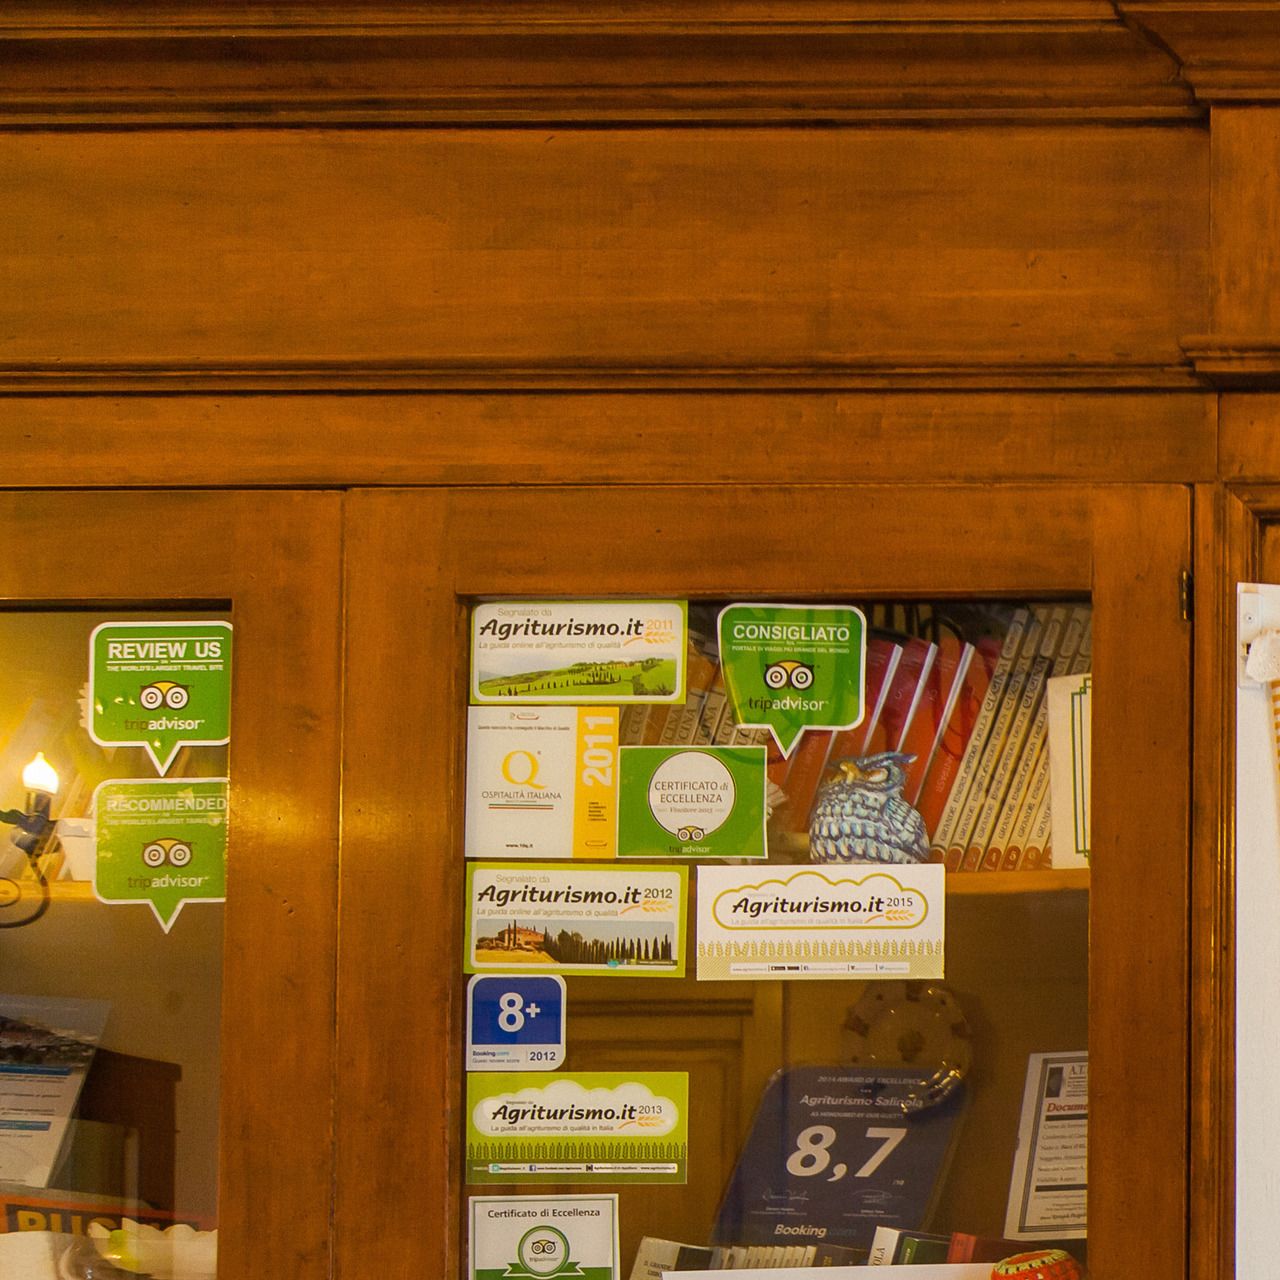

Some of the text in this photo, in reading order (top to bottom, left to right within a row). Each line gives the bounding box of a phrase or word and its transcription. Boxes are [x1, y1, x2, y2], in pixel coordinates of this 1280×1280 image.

[497, 608, 552, 618] Segnalato da
[479, 618, 673, 641] Agriturismo.it 2011
[733, 625, 850, 641] CONSIGLIATO
[108, 641, 221, 659] REVIEW US
[489, 642, 510, 650] guida
[596, 641, 621, 651] qualità
[749, 696, 824, 712] tripadvisor
[124, 716, 200, 733] tripadvisor
[582, 716, 614, 788] 2011
[502, 750, 547, 790] Q
[655, 781, 729, 791] CERTIFICATO di
[482, 790, 562, 799] OSPITALITÀ ITALIANA
[660, 794, 723, 803] ECCELLENZA
[107, 797, 227, 811] RECOMMENDED
[128, 874, 203, 890] tripadvisor
[495, 874, 539, 884] Segnalato
[477, 885, 673, 907] Agriturismo.it 2012
[487, 908, 508, 917] guida
[594, 910, 618, 918] qualità
[731, 896, 913, 917] Agriturismo.it 2015
[529, 1051, 556, 1062] 2012
[799, 1095, 873, 1107] Agriturismo
[491, 1103, 663, 1124] Agriturismo.it 2013
[500, 1125, 518, 1133] guida
[518, 1125, 561, 1133] all'agriturismo
[570, 1125, 591, 1133] qualità
[786, 1124, 908, 1182] 8,7
[487, 1208, 601, 1219] Certificato di Eccellenza
